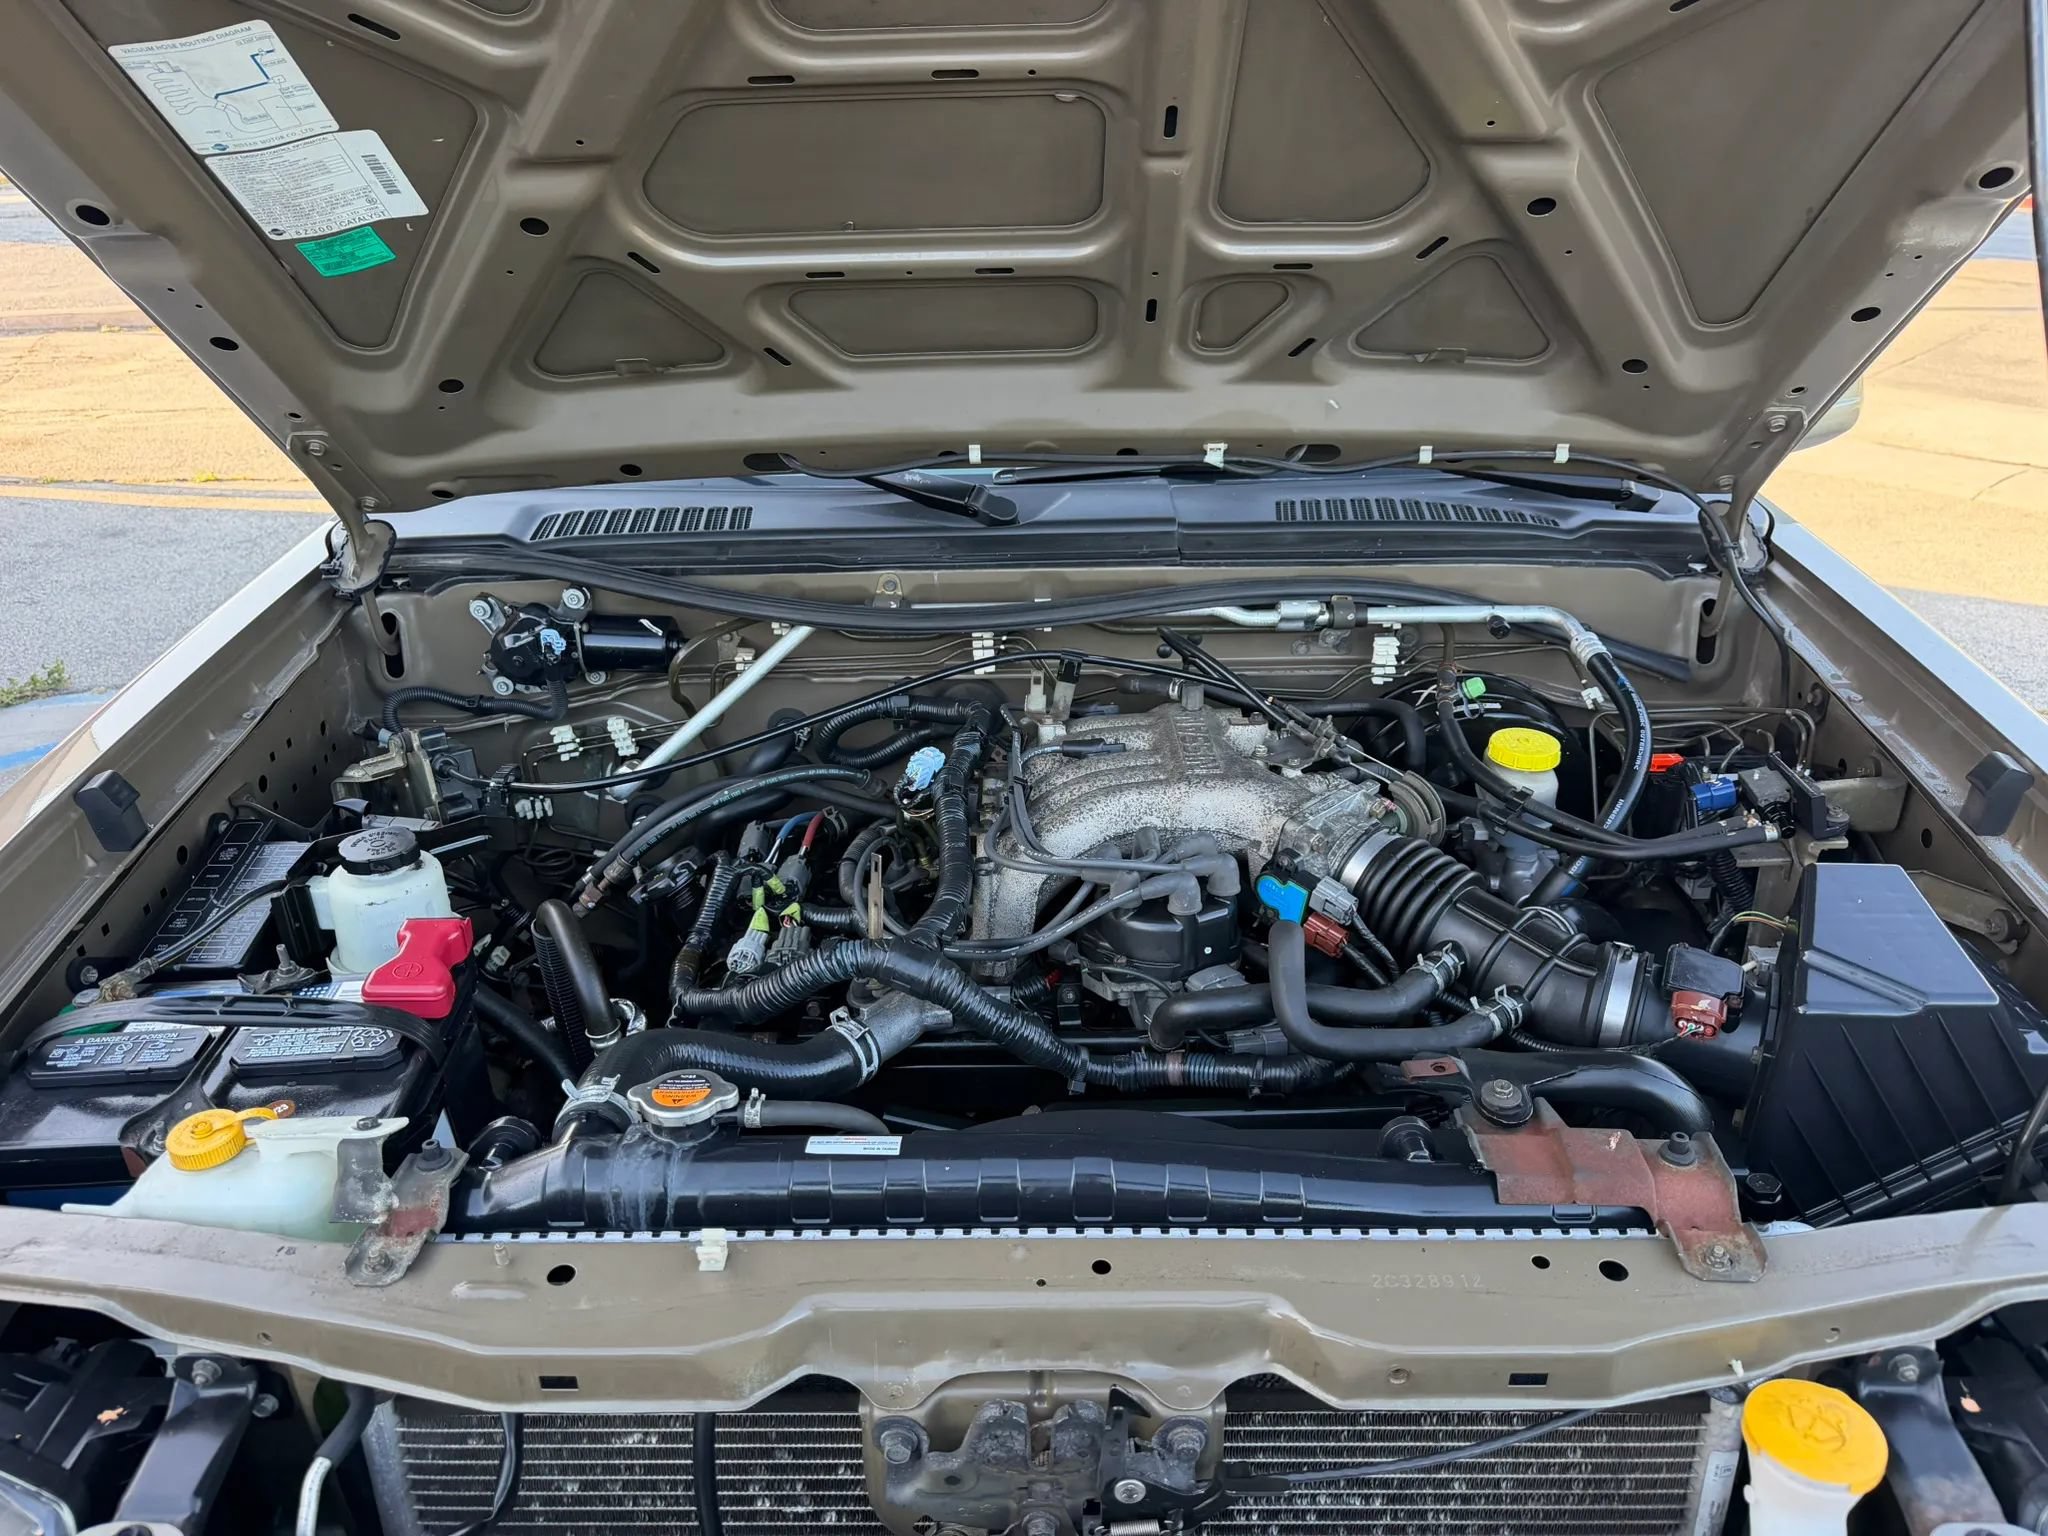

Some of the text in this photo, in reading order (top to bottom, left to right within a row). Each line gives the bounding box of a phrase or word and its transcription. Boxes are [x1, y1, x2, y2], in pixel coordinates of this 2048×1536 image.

[120, 46, 155, 54] VACUUM
[156, 42, 178, 50] HOSE
[178, 36, 216, 48] ROUTING
[216, 26, 252, 40] DIAGRAM
[340, 210, 387, 227] CATALYST
[139, 1032, 179, 1040] POISON
[1370, 1273, 1484, 1289] 2C328912
